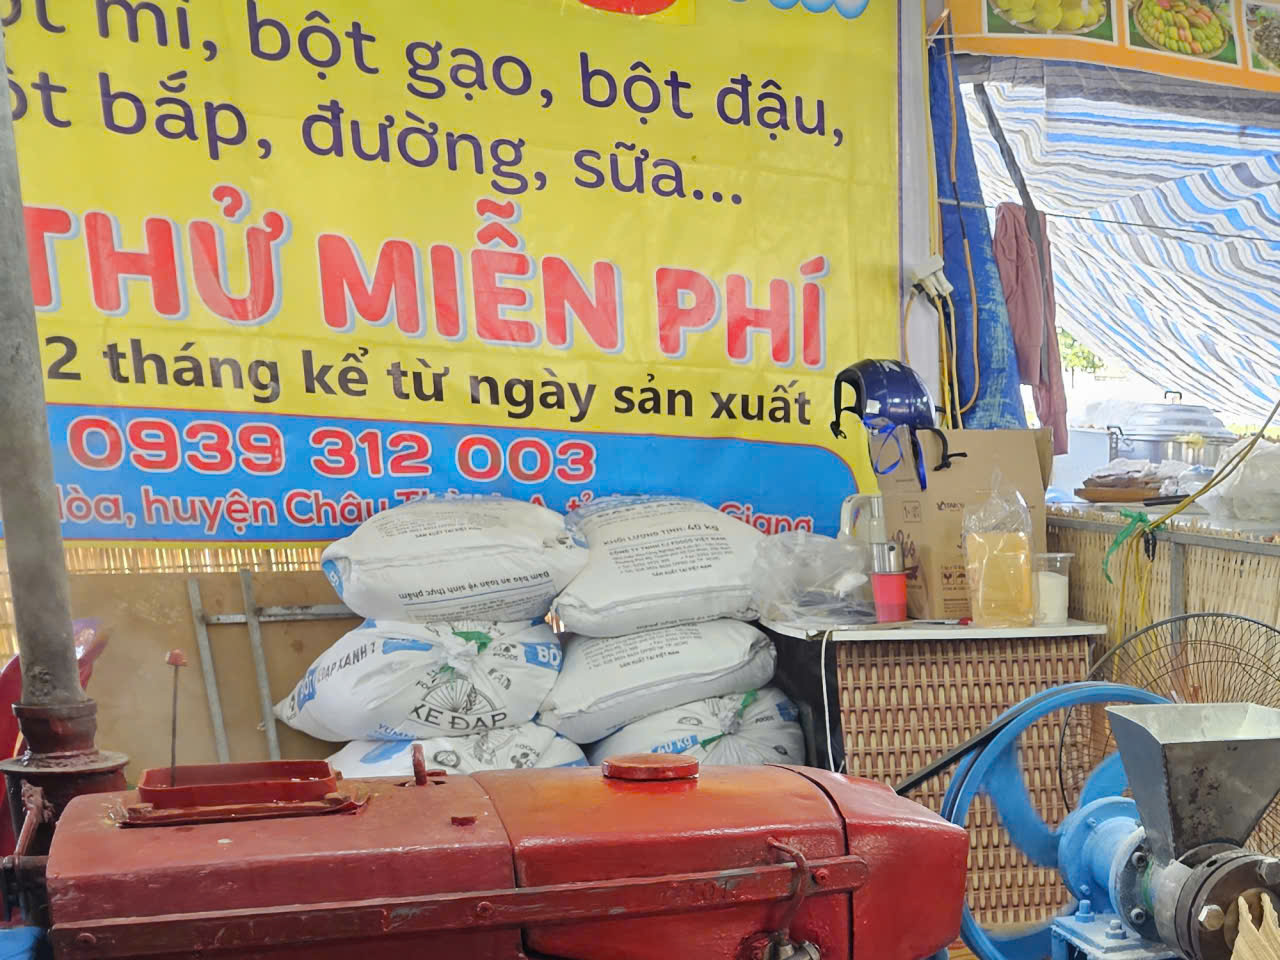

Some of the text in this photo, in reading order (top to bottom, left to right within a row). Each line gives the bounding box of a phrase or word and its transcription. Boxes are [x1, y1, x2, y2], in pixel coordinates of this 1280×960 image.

[246, 0, 380, 81] bột
[405, 41, 552, 108] gạo,
[579, 51, 694, 126] bột
[716, 73, 844, 148] đậu,
[98, 70, 272, 161] bắp,
[302, 99, 547, 196] đường,
[573, 141, 743, 206] sữa...
[22, 183, 828, 367] THỬ MIỄN PHÍ
[102, 337, 281, 404] tháng
[301, 346, 369, 397] kể
[386, 357, 450, 402] từ
[469, 367, 597, 423] ngày
[613, 372, 694, 417] sản
[710, 379, 812, 426] xuất
[68, 416, 597, 485] 0939 312 003
[140, 485, 279, 535] huyện
[285, 489, 390, 526] Châu
